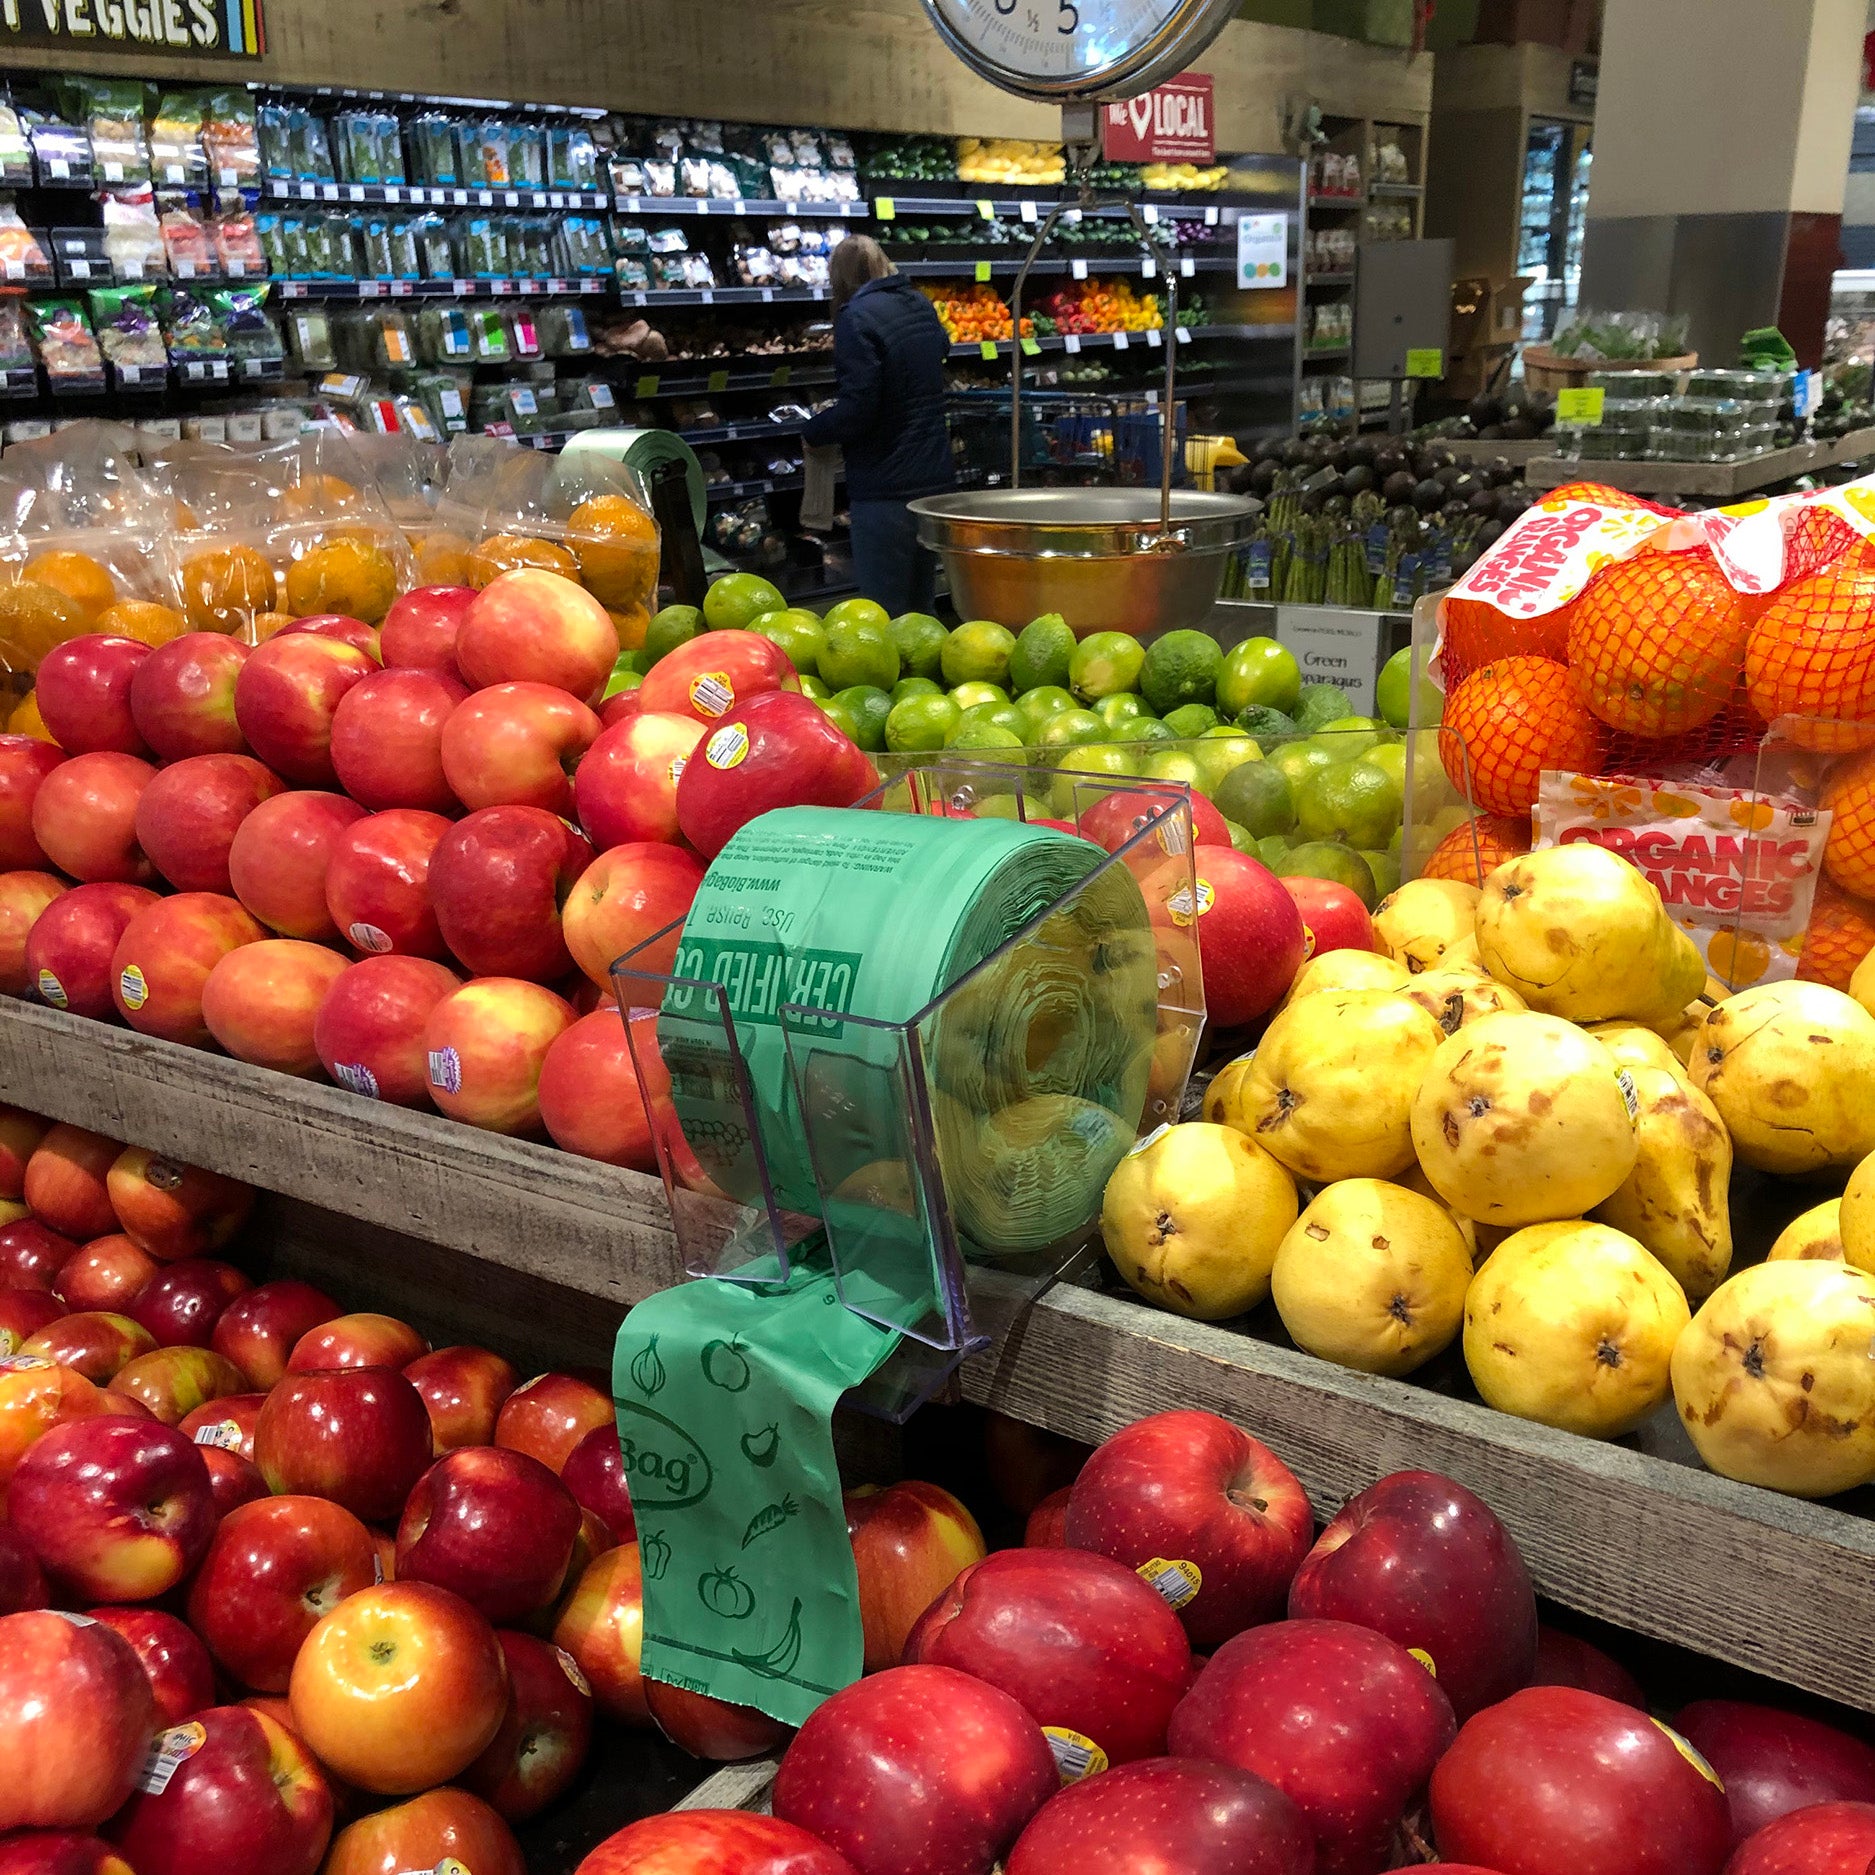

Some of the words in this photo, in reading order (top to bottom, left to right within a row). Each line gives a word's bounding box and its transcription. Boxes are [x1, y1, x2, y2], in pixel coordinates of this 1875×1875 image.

[41, 0, 219, 48] VEGGIES
[1057, 0, 1079, 34] 5
[1153, 93, 1209, 138] LOCAL
[1304, 651, 1348, 668] Green
[1301, 673, 1363, 690] sparagus
[1643, 870, 1794, 913] ANGES
[1178, 1562, 1201, 1586] 94015
